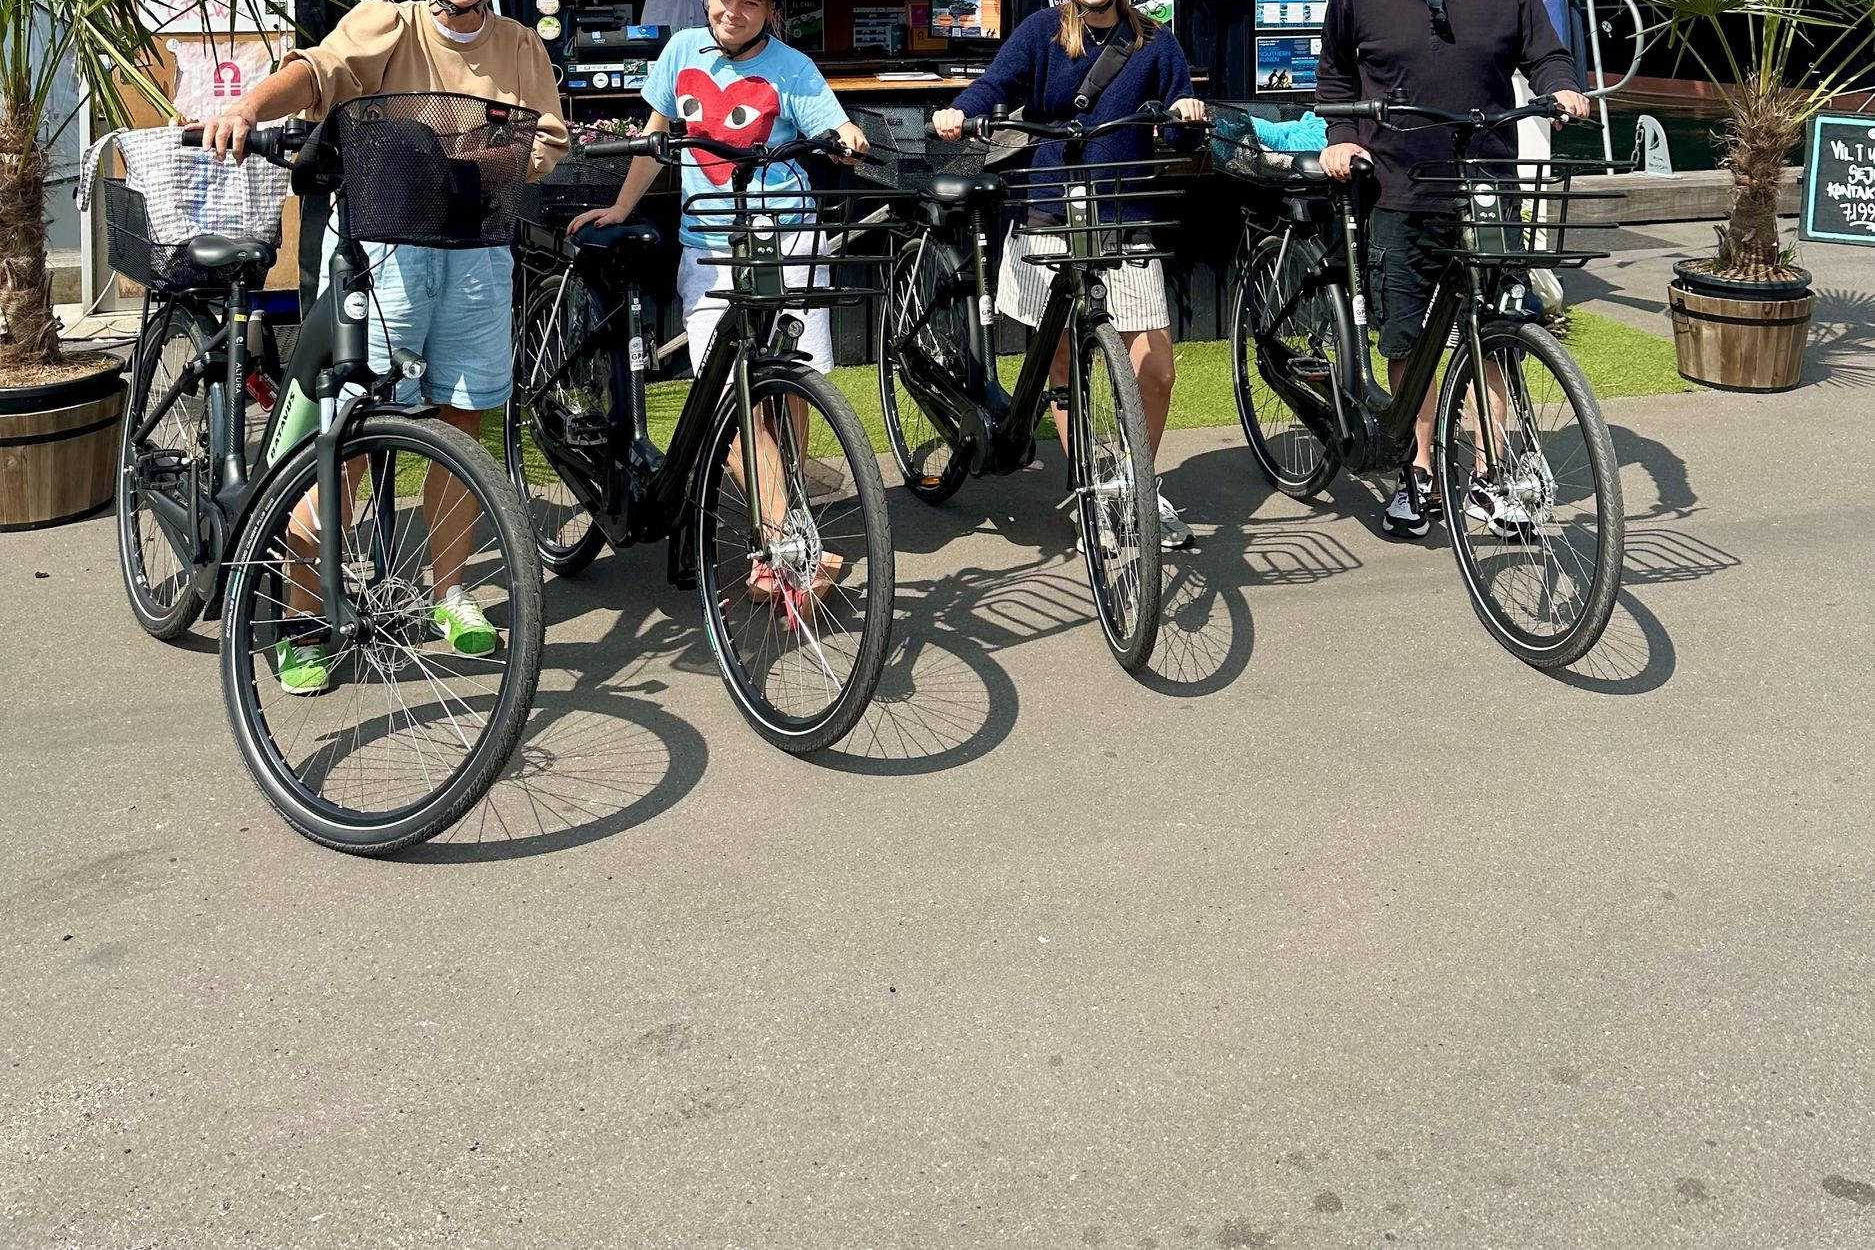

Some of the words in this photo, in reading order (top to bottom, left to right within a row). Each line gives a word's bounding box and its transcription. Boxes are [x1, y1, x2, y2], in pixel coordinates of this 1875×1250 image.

[1848, 164, 1875, 185] SEJ
[1826, 181, 1875, 201] KONTAK
[697, 328, 718, 380] BATAVUS
[235, 362, 243, 394] ALTURA
[270, 391, 296, 460] BATAVUS
